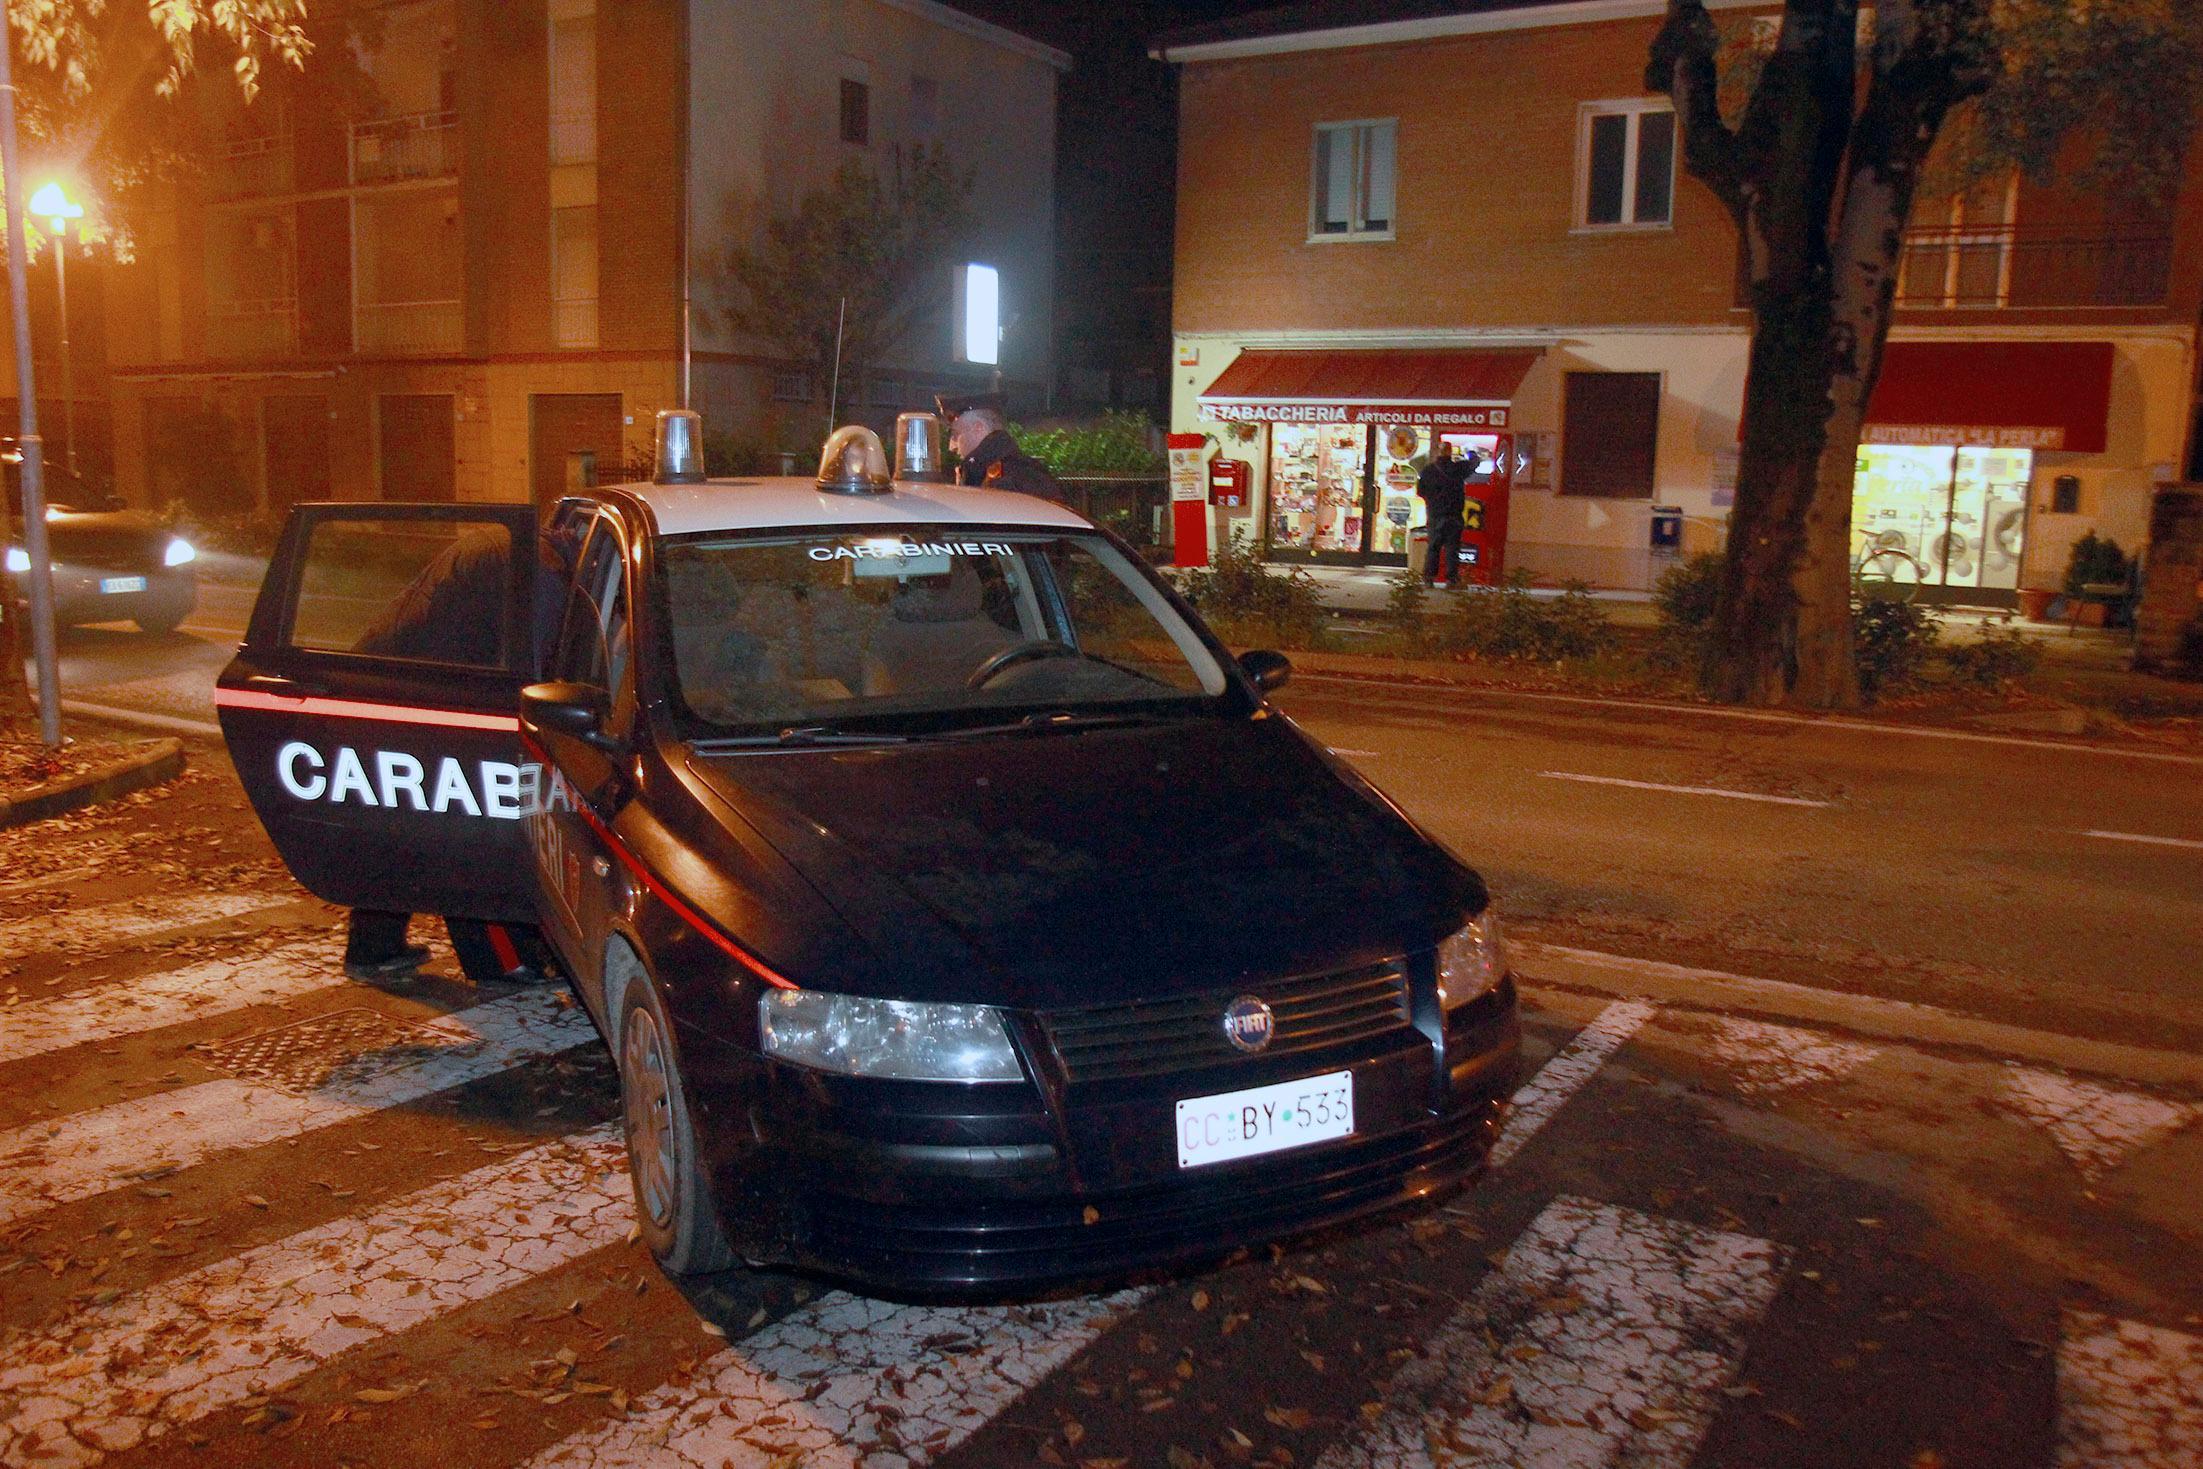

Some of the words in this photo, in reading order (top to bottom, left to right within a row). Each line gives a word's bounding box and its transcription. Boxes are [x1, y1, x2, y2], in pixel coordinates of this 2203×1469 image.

[1220, 405, 1347, 422] TABACCHERIA
[1356, 412, 1411, 424] ARTICOLI
[1414, 412, 1431, 424] DA
[1433, 413, 1485, 425] REGALO
[808, 542, 1014, 562] CARABINIERI
[1234, 1013, 1267, 1033] FIAT
[1183, 1112, 1220, 1151] CC
[1243, 1101, 1276, 1140] BY
[1296, 1088, 1349, 1129] 533
